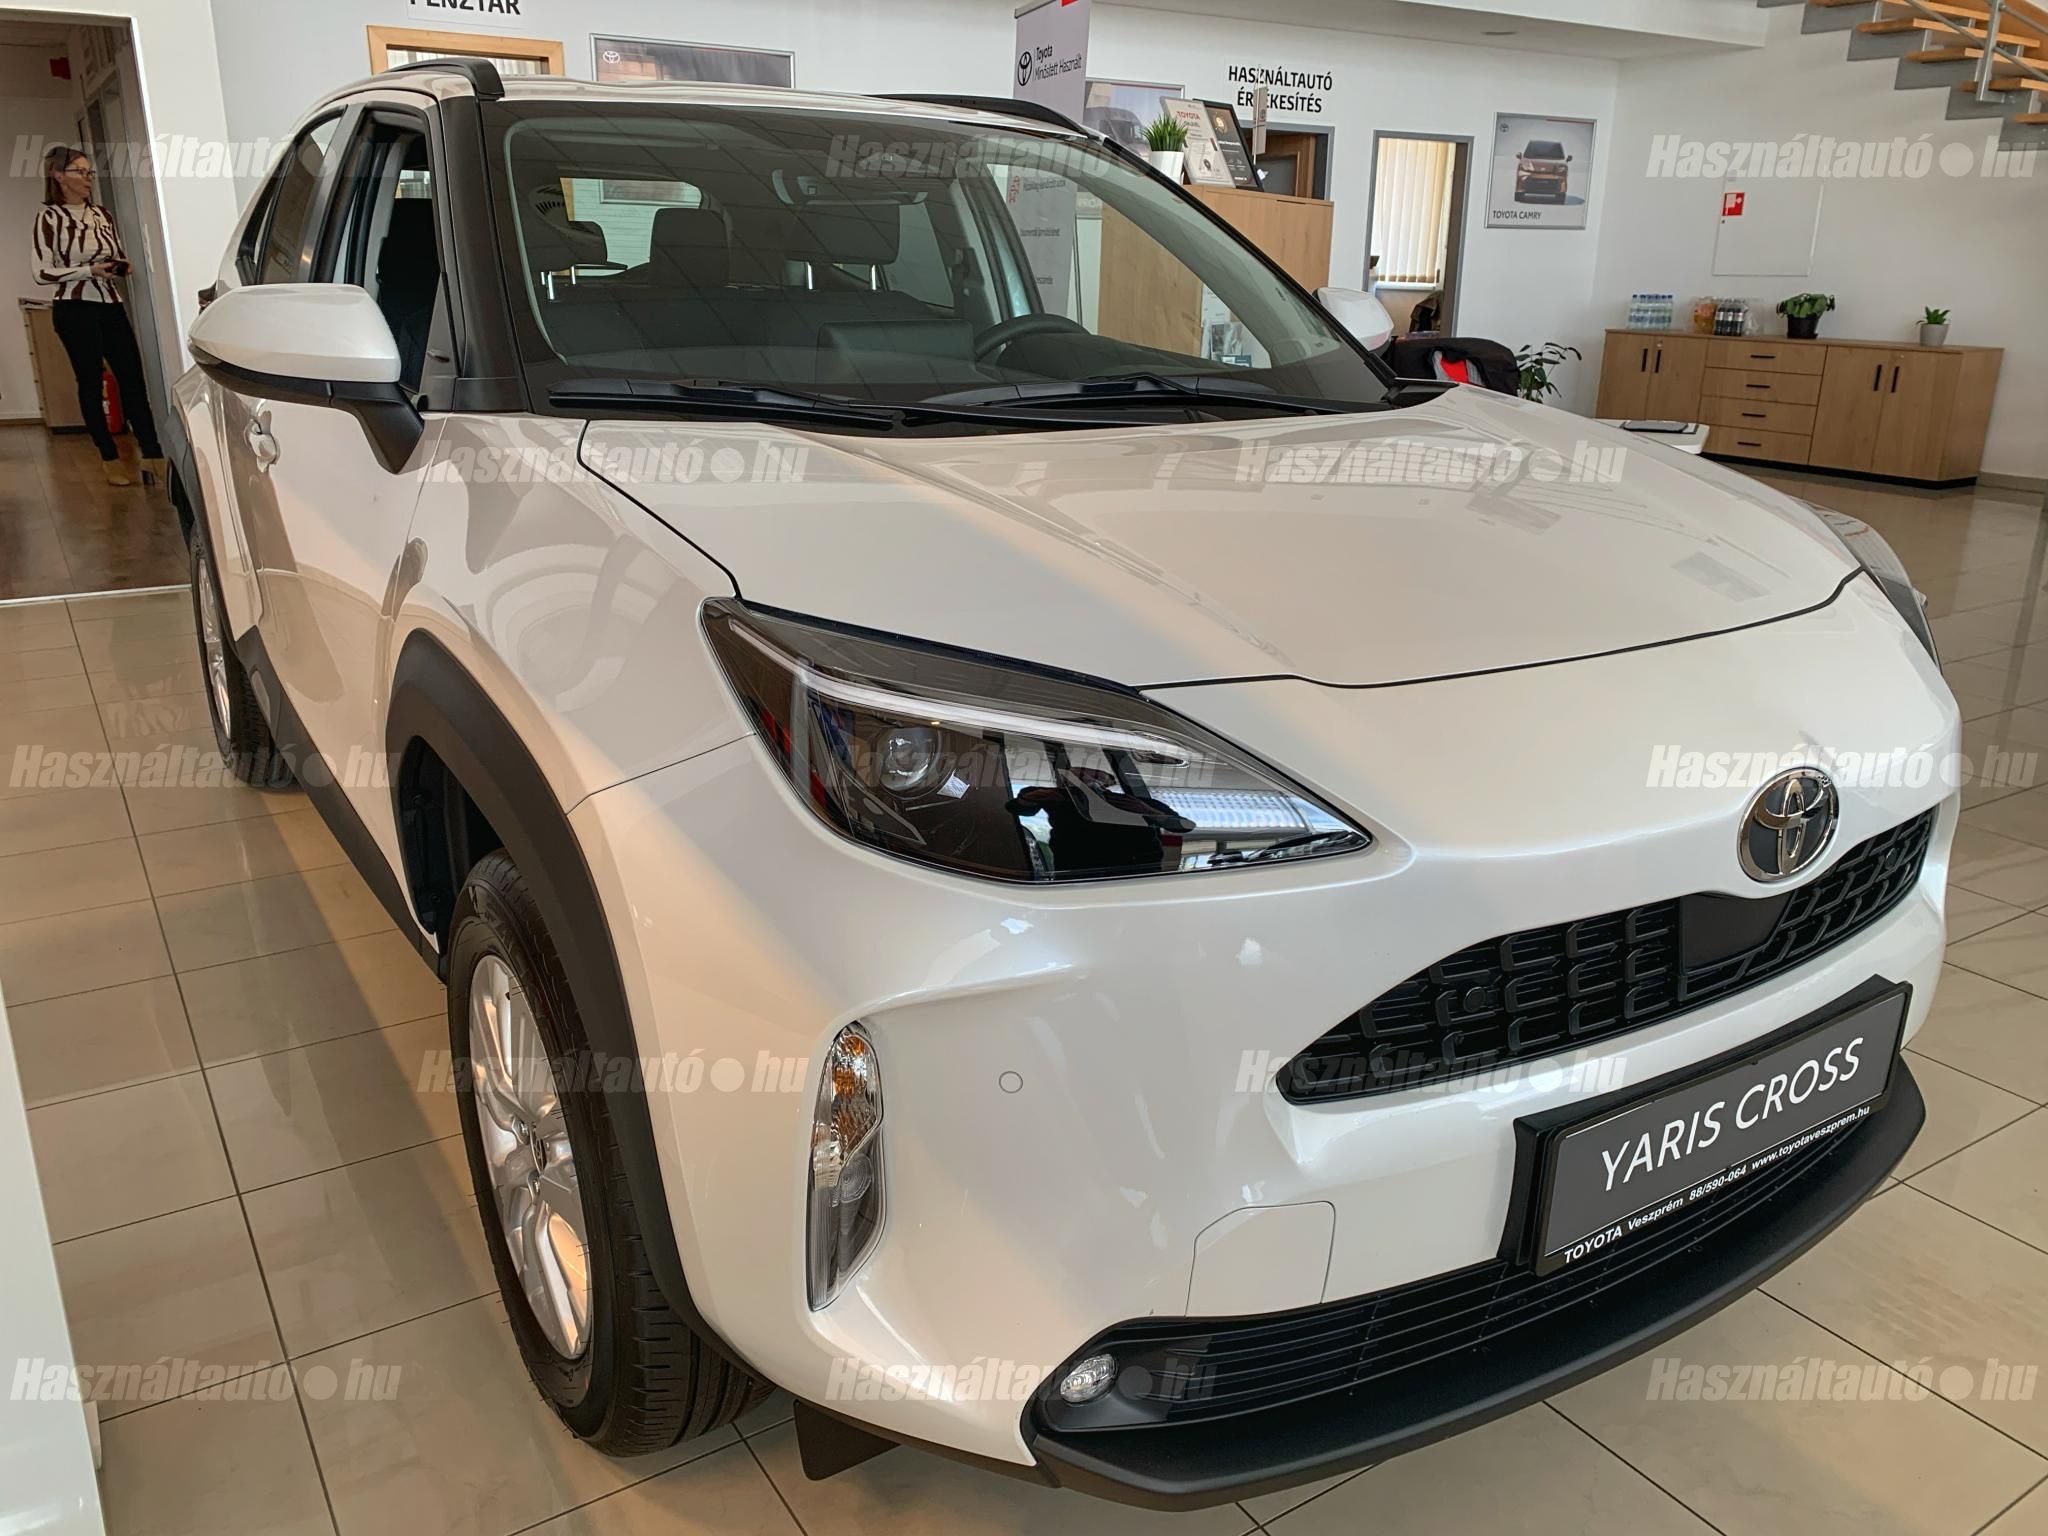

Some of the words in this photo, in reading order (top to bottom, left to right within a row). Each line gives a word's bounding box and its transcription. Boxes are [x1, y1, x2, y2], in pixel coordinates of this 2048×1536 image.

[1228, 65, 1333, 91] HASZNÁLTAUTÓ
[1237, 86, 1322, 113] ÉRKESÍTÉS
[1492, 209, 1518, 219] TOYOTA
[1518, 210, 1542, 220] CAMRY
[1601, 1101, 1726, 1192] YARIS
[1735, 1037, 1864, 1129] CROSS
[1564, 1227, 1623, 1264] TOYOTA
[1628, 1197, 1684, 1231] Veszprém
[1689, 1166, 1748, 1201] 88/590-064
[1751, 1104, 1871, 1171] www.toyotaveszprem.hu
